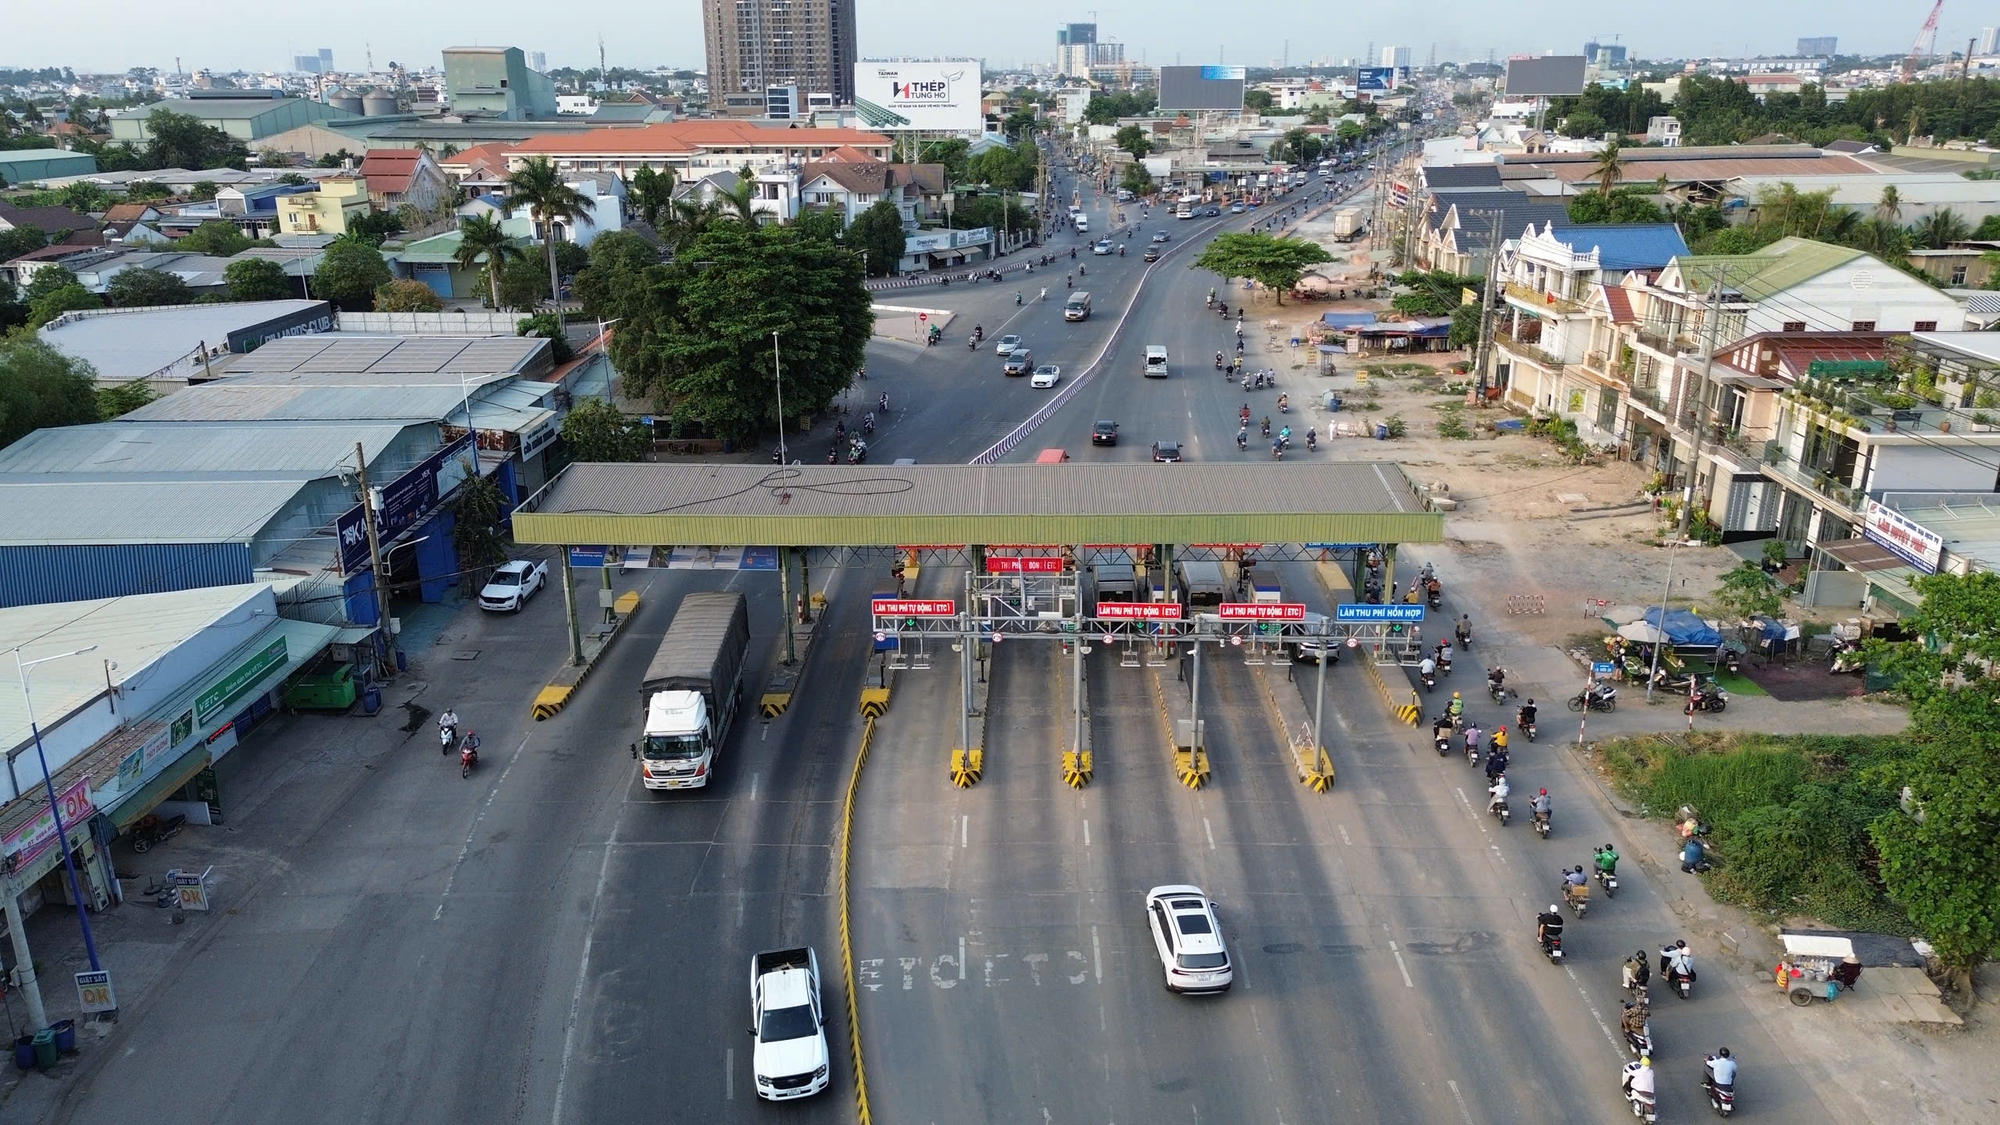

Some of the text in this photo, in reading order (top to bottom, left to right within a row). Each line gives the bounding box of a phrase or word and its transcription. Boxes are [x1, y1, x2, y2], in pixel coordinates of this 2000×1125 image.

[911, 79, 946, 92] THÉP
[308, 316, 330, 334] CLUB
[1012, 560, 1020, 569] PH
[875, 603, 886, 611] LÀN
[899, 603, 908, 611] PHÍ
[909, 604, 916, 613] TỰ
[917, 603, 931, 613] ĐỘNG
[1100, 606, 1110, 614] LÀN
[1124, 606, 1134, 615] PHÍ
[1134, 607, 1142, 616] TỰ
[1144, 606, 1159, 617] ĐỘNG
[1222, 606, 1234, 615] LÀN
[1247, 606, 1258, 615] PHÍ
[1258, 608, 1266, 617] TỰ
[1267, 606, 1282, 617] ĐỘNG
[1340, 607, 1354, 616] LÀN
[1372, 608, 1385, 616] PHÍ
[1405, 609, 1421, 619] HỢP
[199, 691, 219, 712] VETC
[252, 661, 263, 672] VETC
[66, 786, 89, 820] OK
[181, 890, 204, 906] OK
[83, 987, 110, 1006] OK
